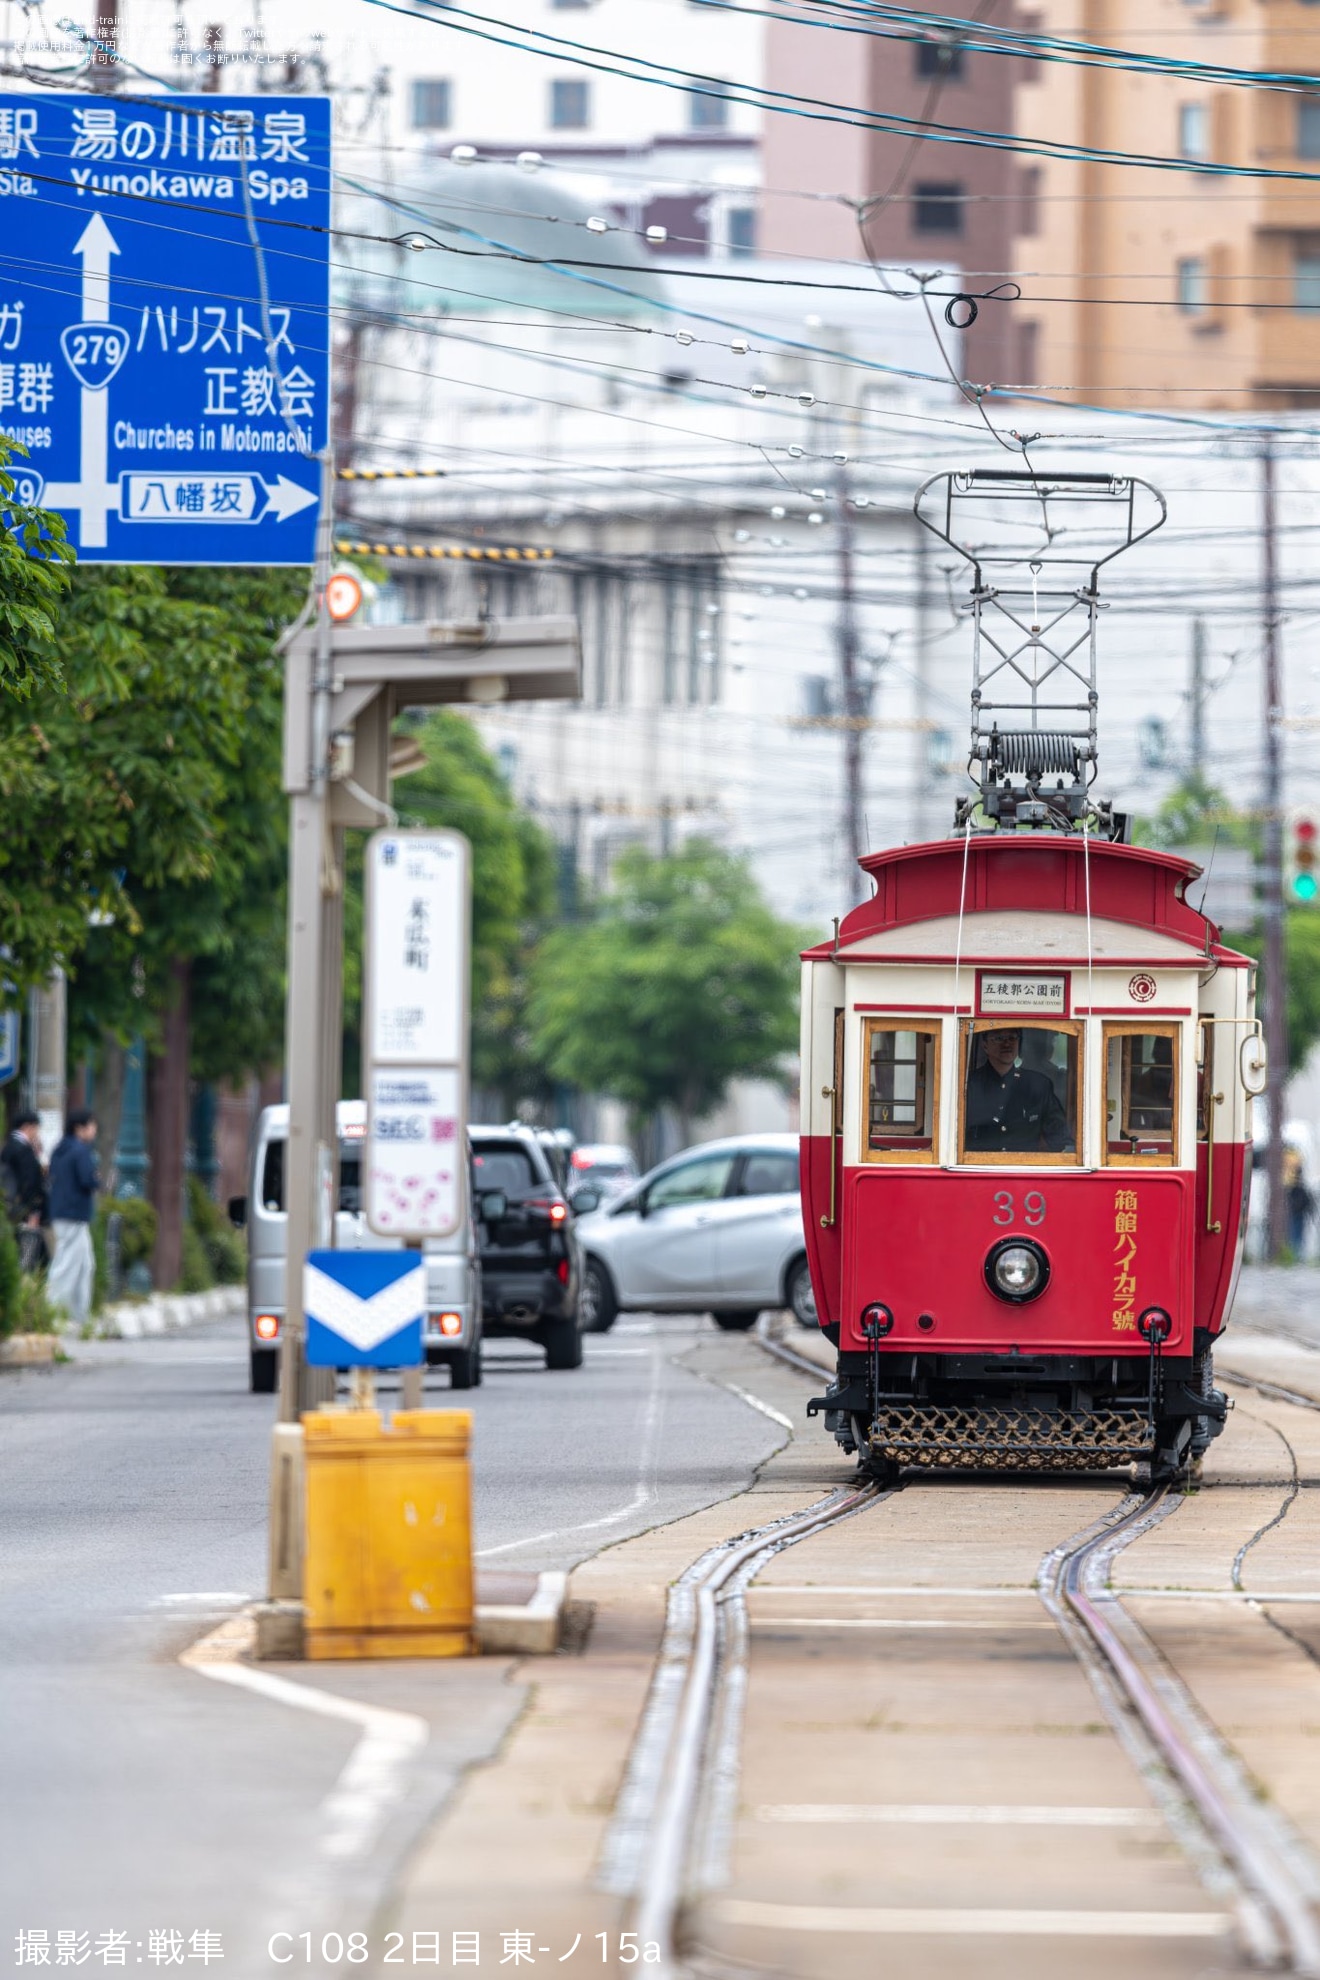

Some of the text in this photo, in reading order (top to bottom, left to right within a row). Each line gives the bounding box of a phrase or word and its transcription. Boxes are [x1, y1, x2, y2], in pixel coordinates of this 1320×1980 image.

[70, 108, 310, 163] 湯の川温泉
[71, 168, 234, 199] Yunokawa
[249, 170, 309, 206] Spa
[136, 305, 297, 355] ハリストス
[72, 335, 121, 366] 279
[203, 364, 316, 417] 正教会
[0, 425, 52, 448] ouses
[114, 420, 312, 452] Churches in Motomachi
[139, 482, 243, 513] 八幡坂
[983, 982, 1063, 998] 五稜郭公園前
[993, 1190, 1047, 1227] 39
[1112, 1189, 1138, 1331] 箱館ハイカラ號
